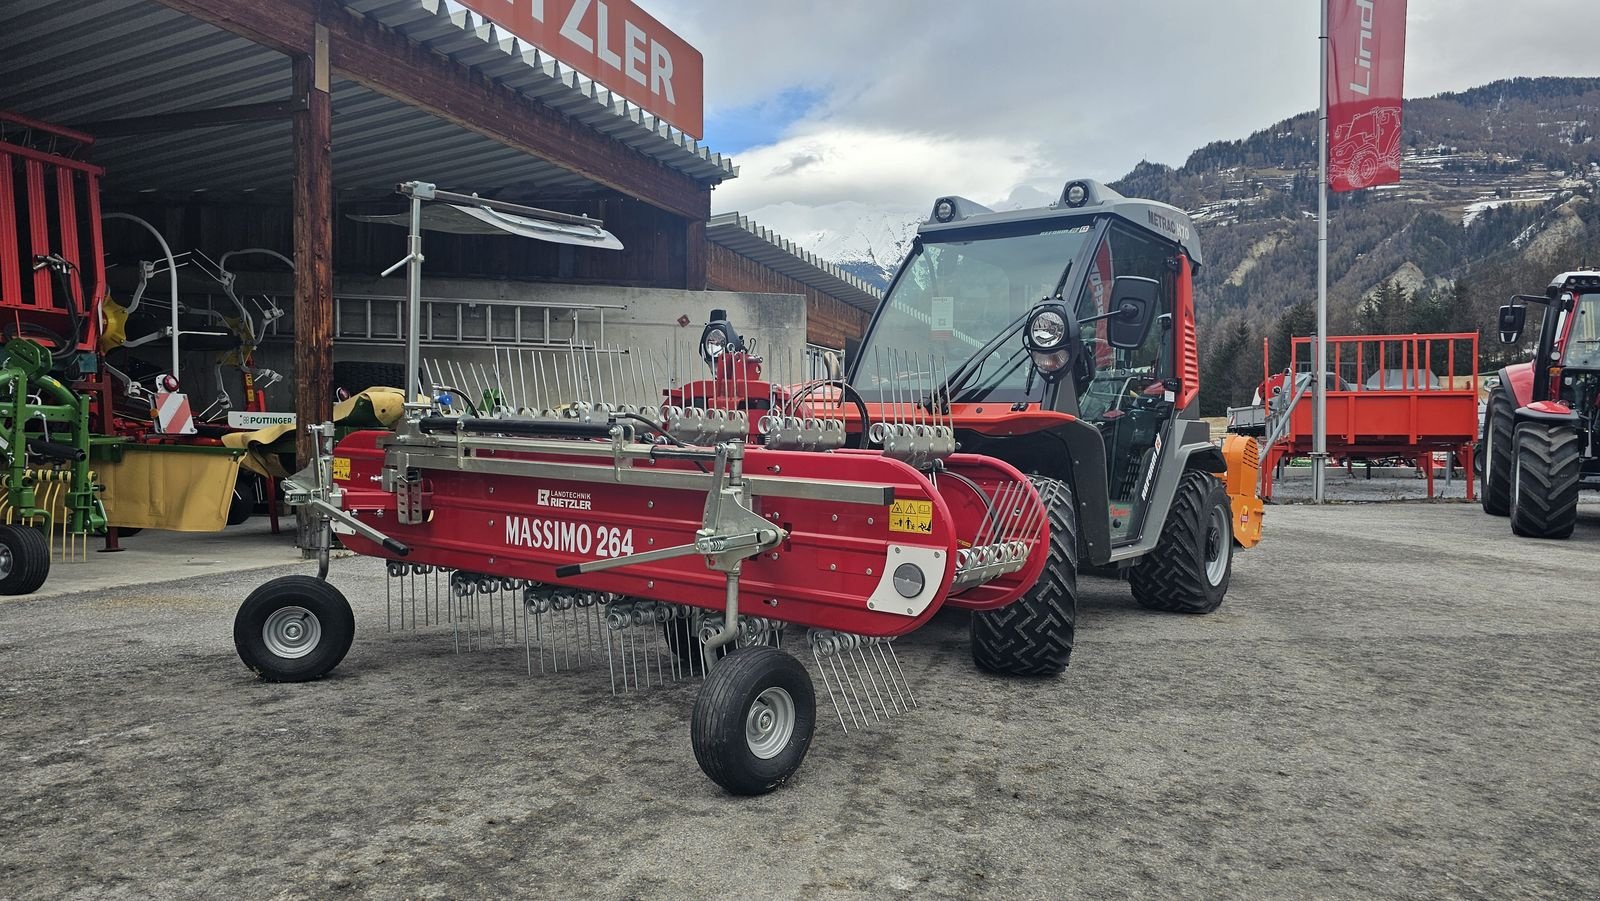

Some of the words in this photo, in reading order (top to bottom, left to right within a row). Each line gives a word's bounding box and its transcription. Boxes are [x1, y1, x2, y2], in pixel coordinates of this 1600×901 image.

[1147, 209, 1176, 234] METRAC
[1141, 451, 1157, 501] REFORM
[550, 490, 591, 500] LANDTECHNIK
[550, 497, 591, 510] RIETZLER
[506, 515, 592, 554] MASSIMO
[596, 525, 634, 558] 264
